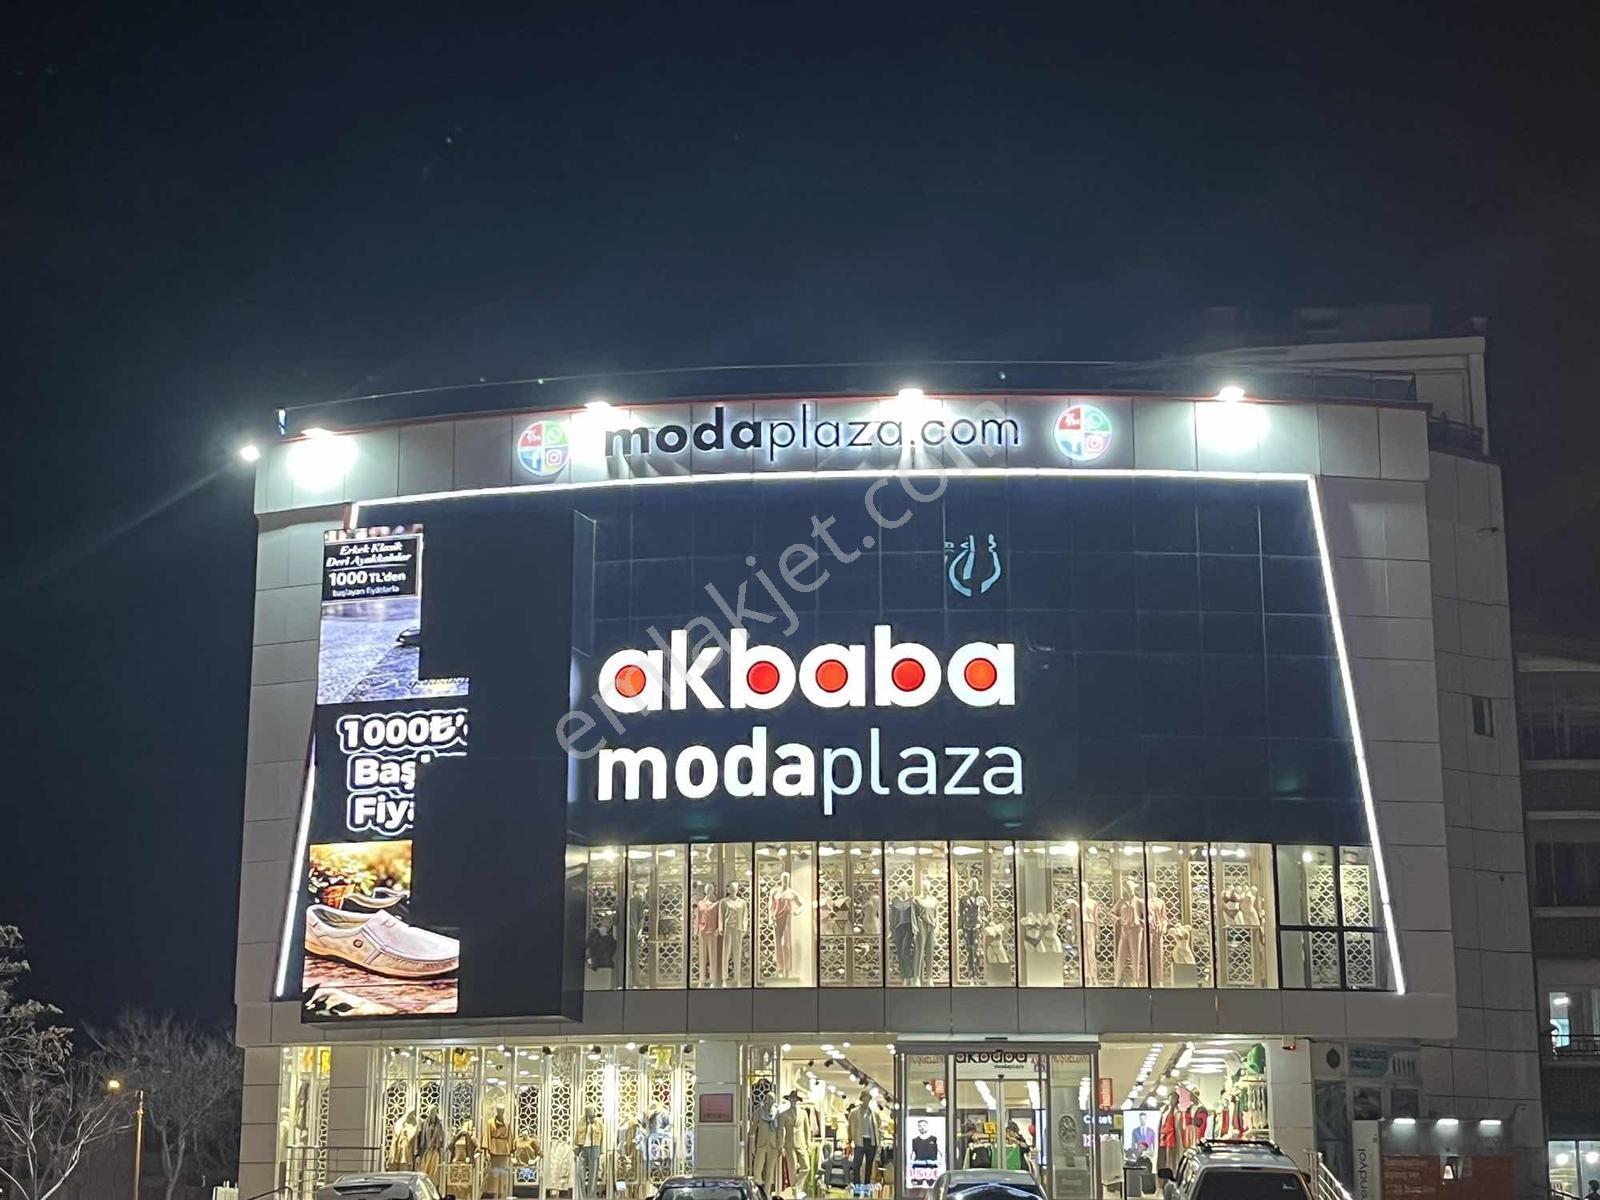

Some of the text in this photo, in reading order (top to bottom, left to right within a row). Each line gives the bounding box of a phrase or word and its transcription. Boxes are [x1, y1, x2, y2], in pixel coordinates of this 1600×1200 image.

[605, 404, 1021, 461] modaplaza.com
[325, 557, 351, 567] Deri
[328, 570, 407, 586] 1000 TL'den
[598, 624, 1015, 713] akbaba
[355, 754, 430, 791] Baş
[597, 726, 1023, 815] modaplaza
[1357, 1149, 1368, 1200] endyol
